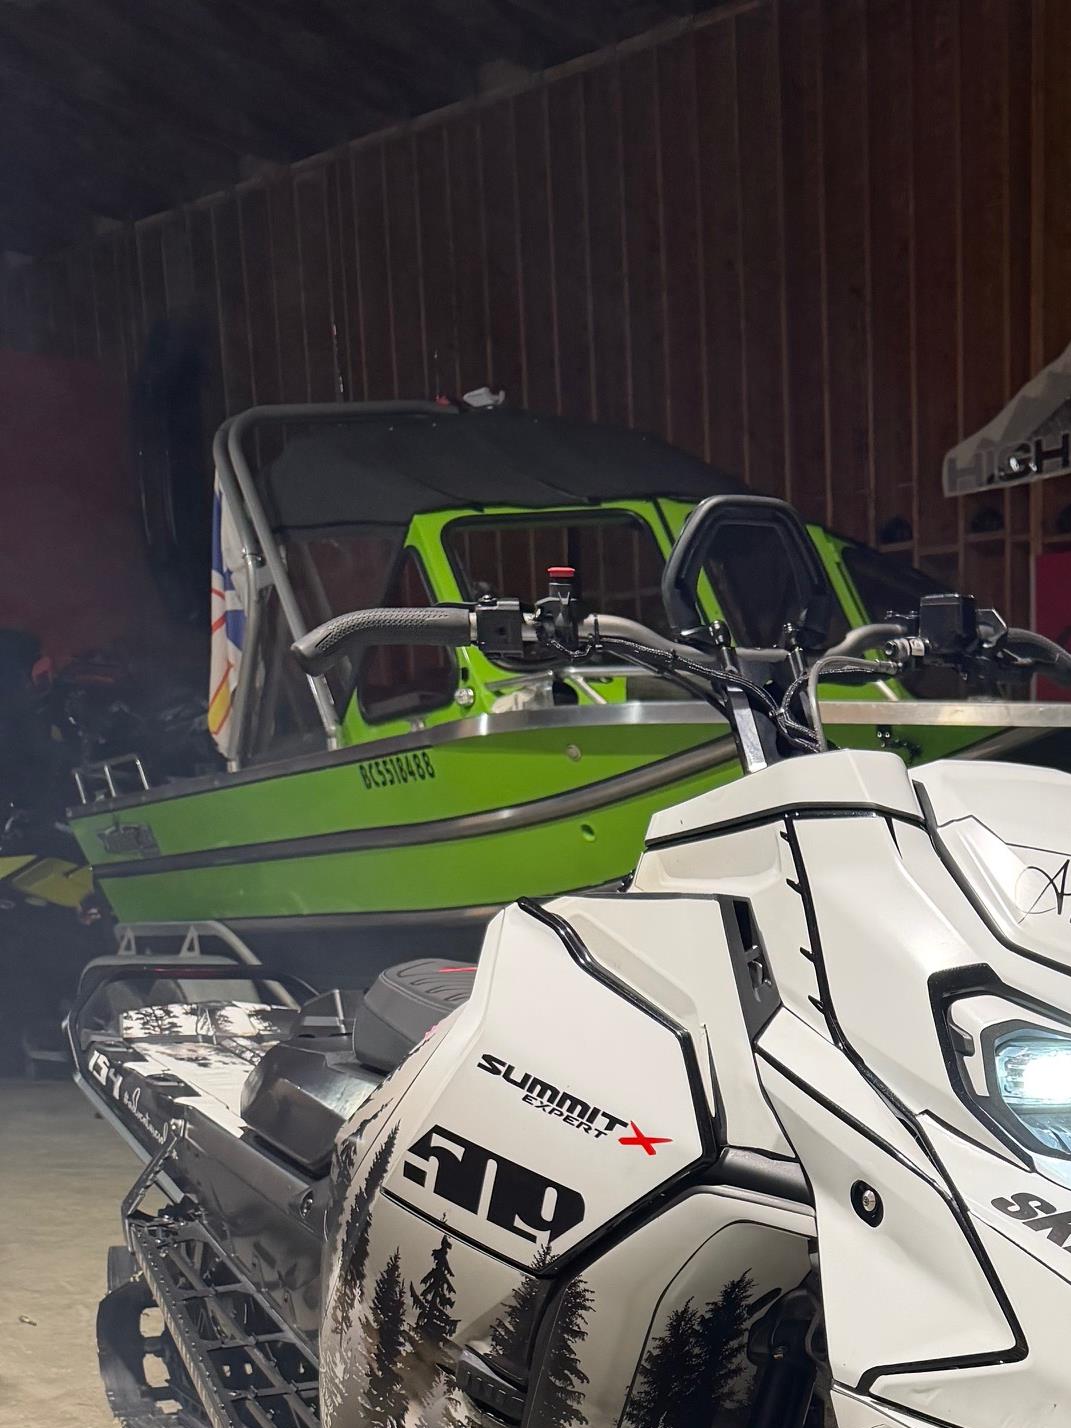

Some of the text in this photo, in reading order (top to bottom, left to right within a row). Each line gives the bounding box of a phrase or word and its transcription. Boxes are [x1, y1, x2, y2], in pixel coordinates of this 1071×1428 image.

[88, 1050, 123, 1100] 154
[477, 1054, 673, 1156] SUMMIT X
[522, 1095, 610, 1140] EXPERT
[403, 1124, 586, 1247] 509
